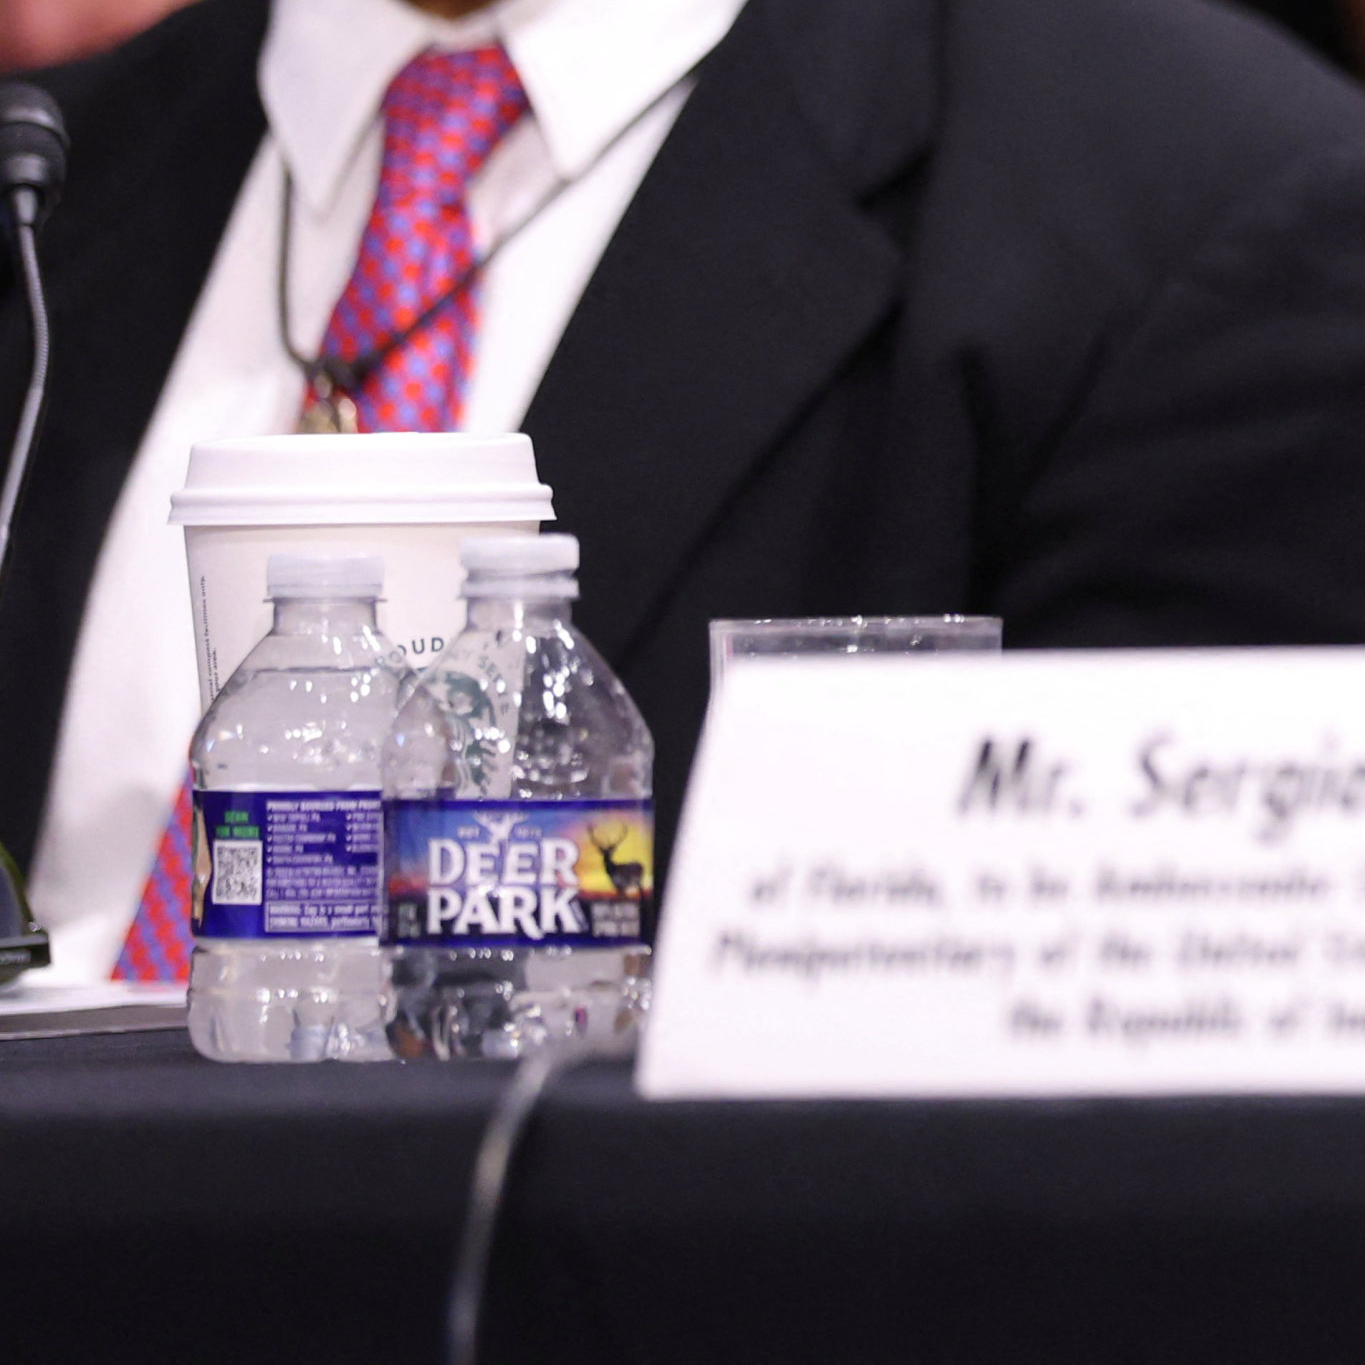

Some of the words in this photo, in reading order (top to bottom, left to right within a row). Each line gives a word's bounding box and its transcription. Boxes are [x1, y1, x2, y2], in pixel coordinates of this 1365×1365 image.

[953, 733, 1086, 820] Mr.
[427, 838, 580, 886] DEER
[426, 885, 582, 940] PARK
